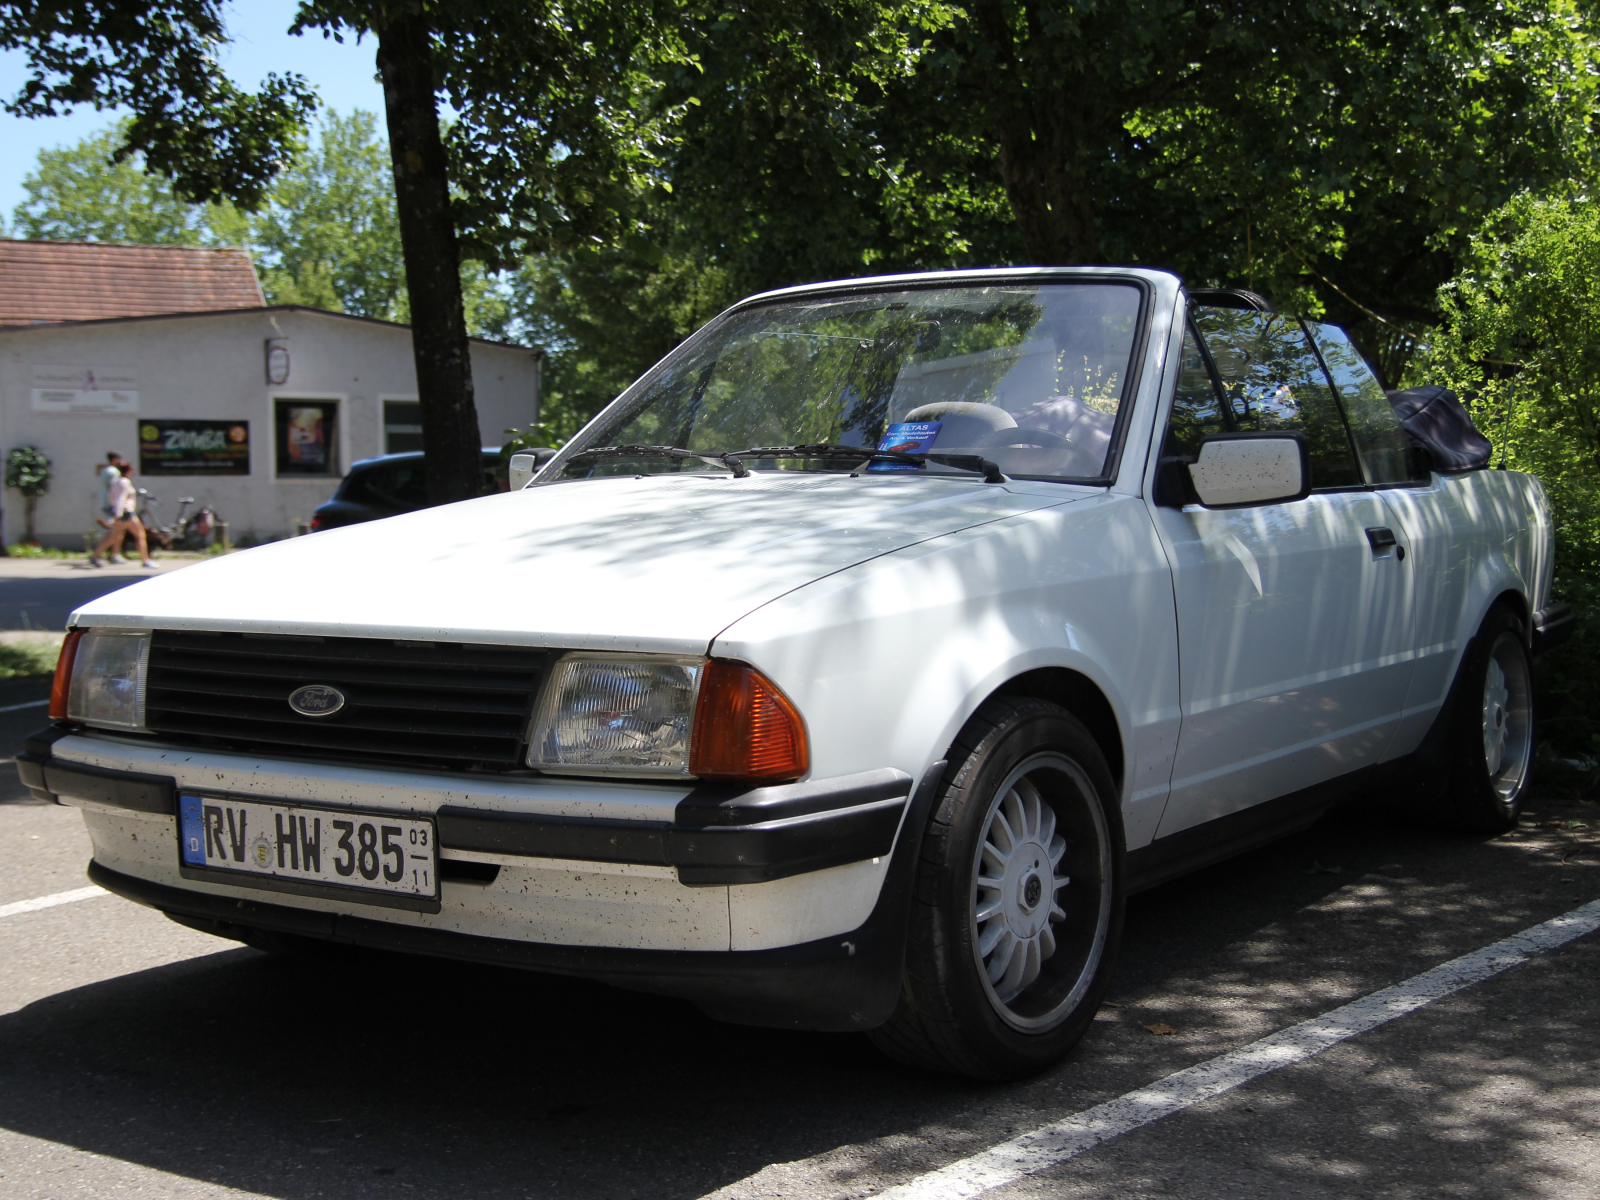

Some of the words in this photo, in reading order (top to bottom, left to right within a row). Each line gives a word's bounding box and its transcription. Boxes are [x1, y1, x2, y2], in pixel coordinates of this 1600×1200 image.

[163, 429, 228, 450] ZUMBA
[300, 690, 329, 708] Ford
[190, 837, 199, 852] D
[204, 805, 247, 863] RV
[275, 813, 321, 873] HW
[332, 819, 405, 883] 385
[409, 828, 428, 847] 03
[412, 869, 428, 887] 11
